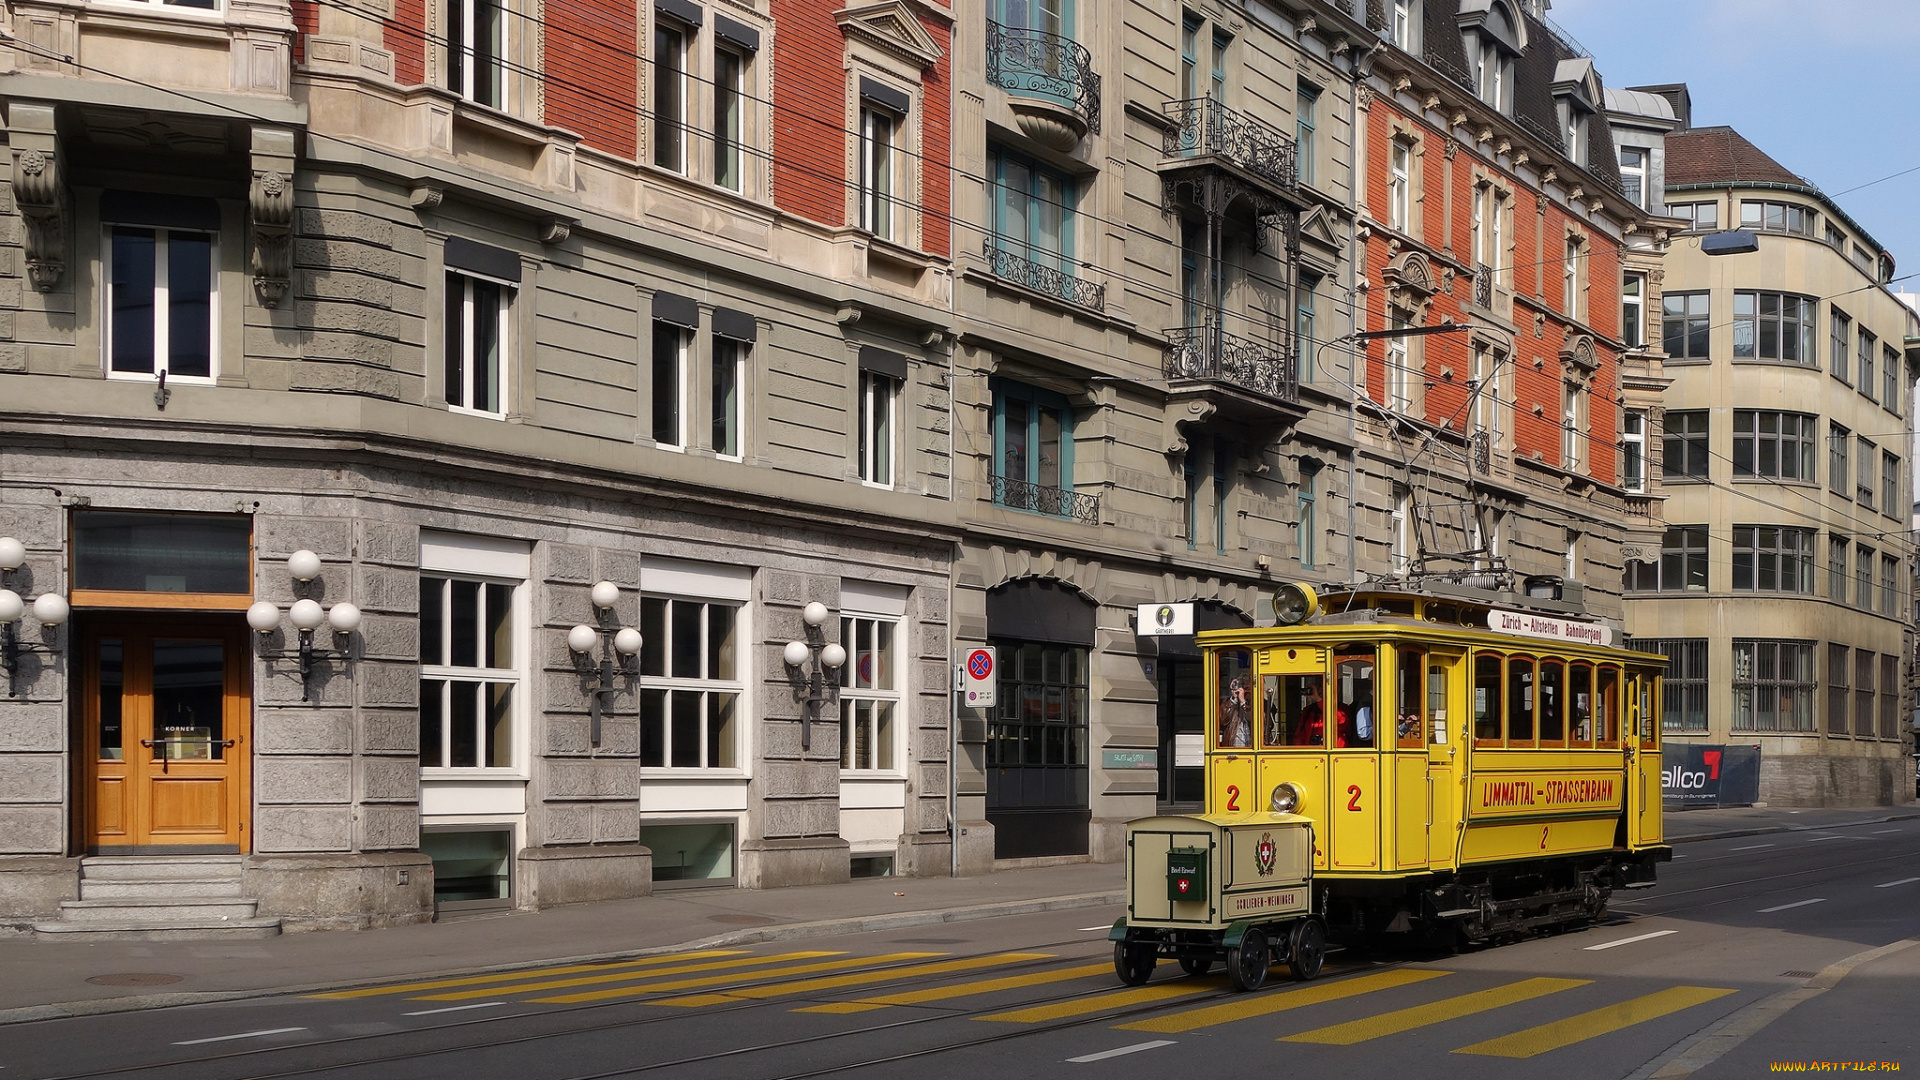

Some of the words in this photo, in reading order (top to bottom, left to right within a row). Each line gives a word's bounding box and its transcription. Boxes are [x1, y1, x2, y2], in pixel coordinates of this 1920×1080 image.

[1501, 613, 1521, 631] Zürich
[1530, 617, 1559, 636] Altstetten
[1565, 622, 1602, 645] Bahnübergang
[1662, 765, 1706, 788] allco
[1226, 785, 1240, 811] 2
[1347, 785, 1362, 811] 2
[1540, 826, 1549, 849] 2
